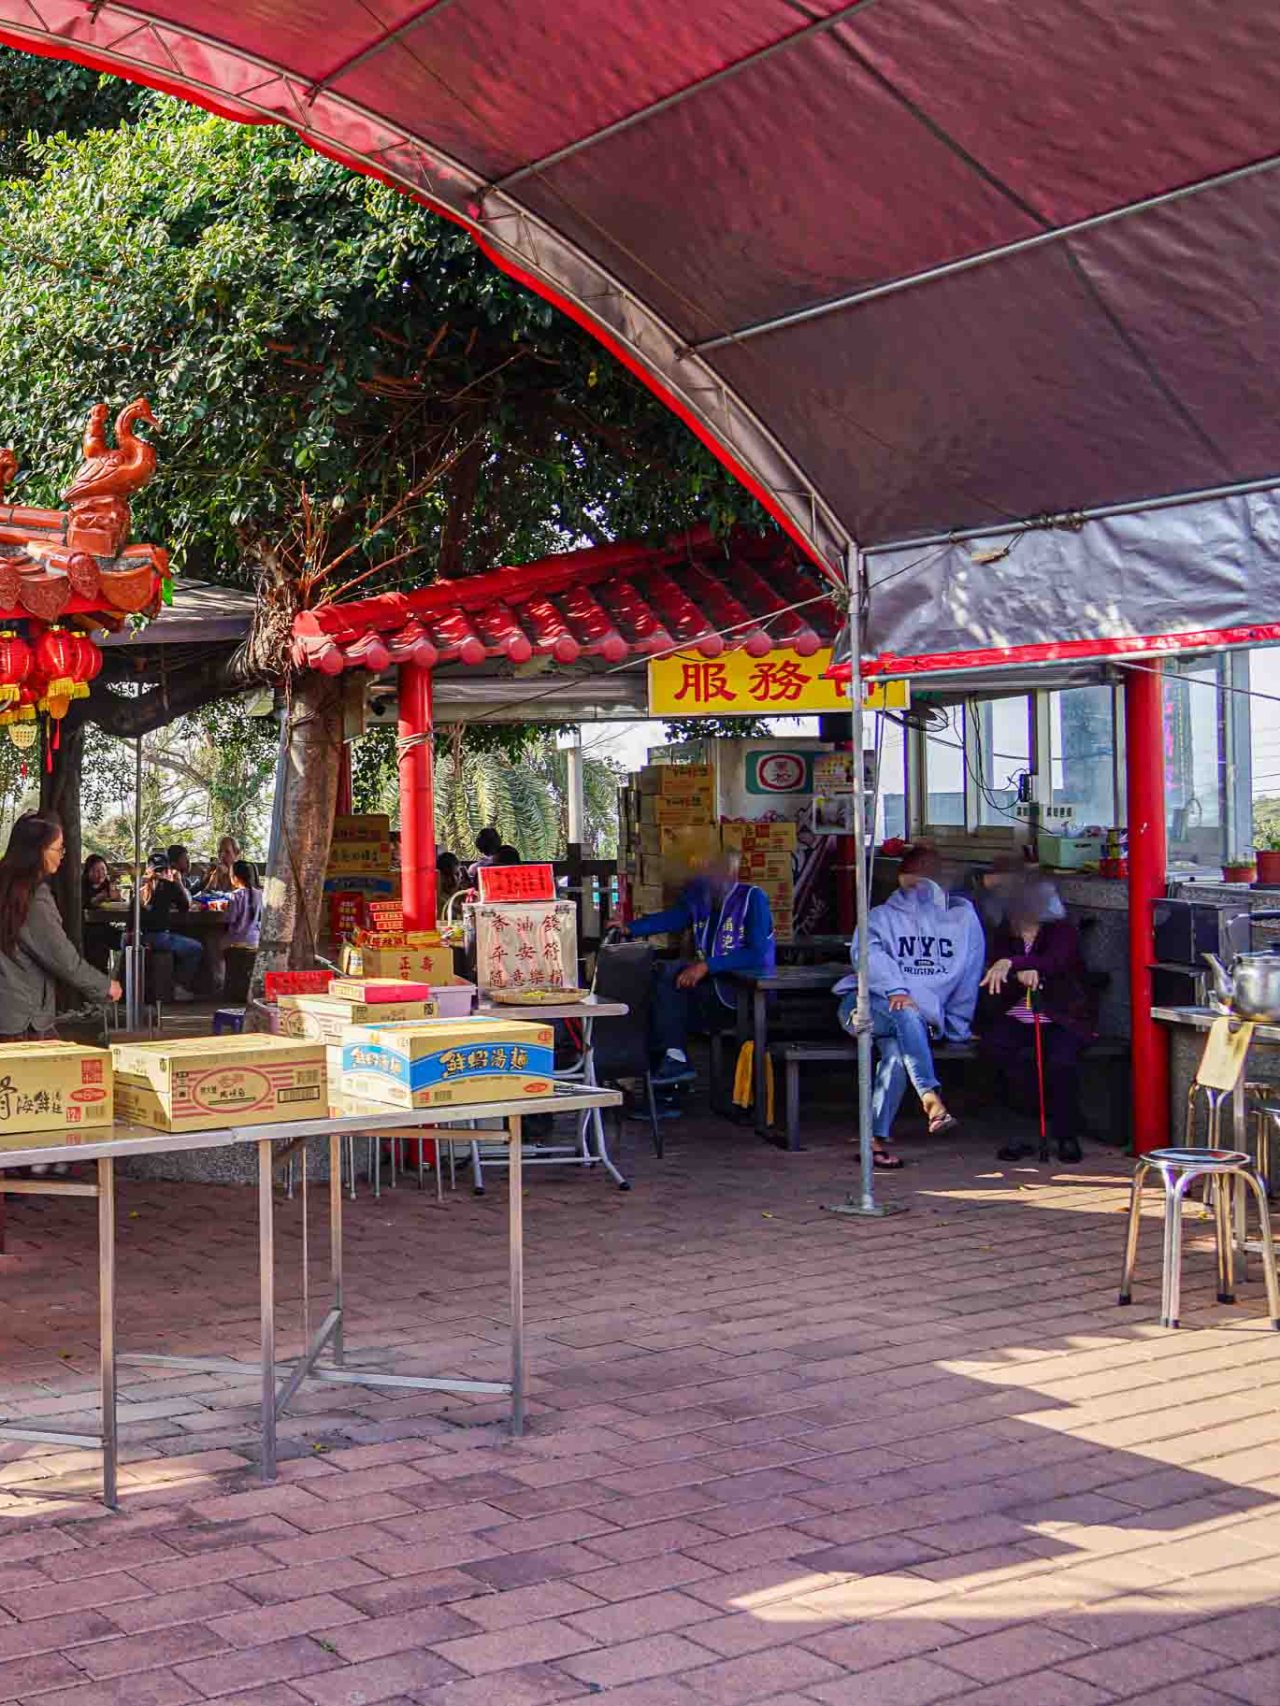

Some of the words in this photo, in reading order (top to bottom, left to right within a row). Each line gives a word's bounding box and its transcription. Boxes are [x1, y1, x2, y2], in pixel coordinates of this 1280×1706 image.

[490, 914, 561, 933] 香油錢
[488, 942, 561, 961] 平安符
[897, 936, 954, 958] NYC
[439, 1046, 529, 1079] 鮮蝦湯麵
